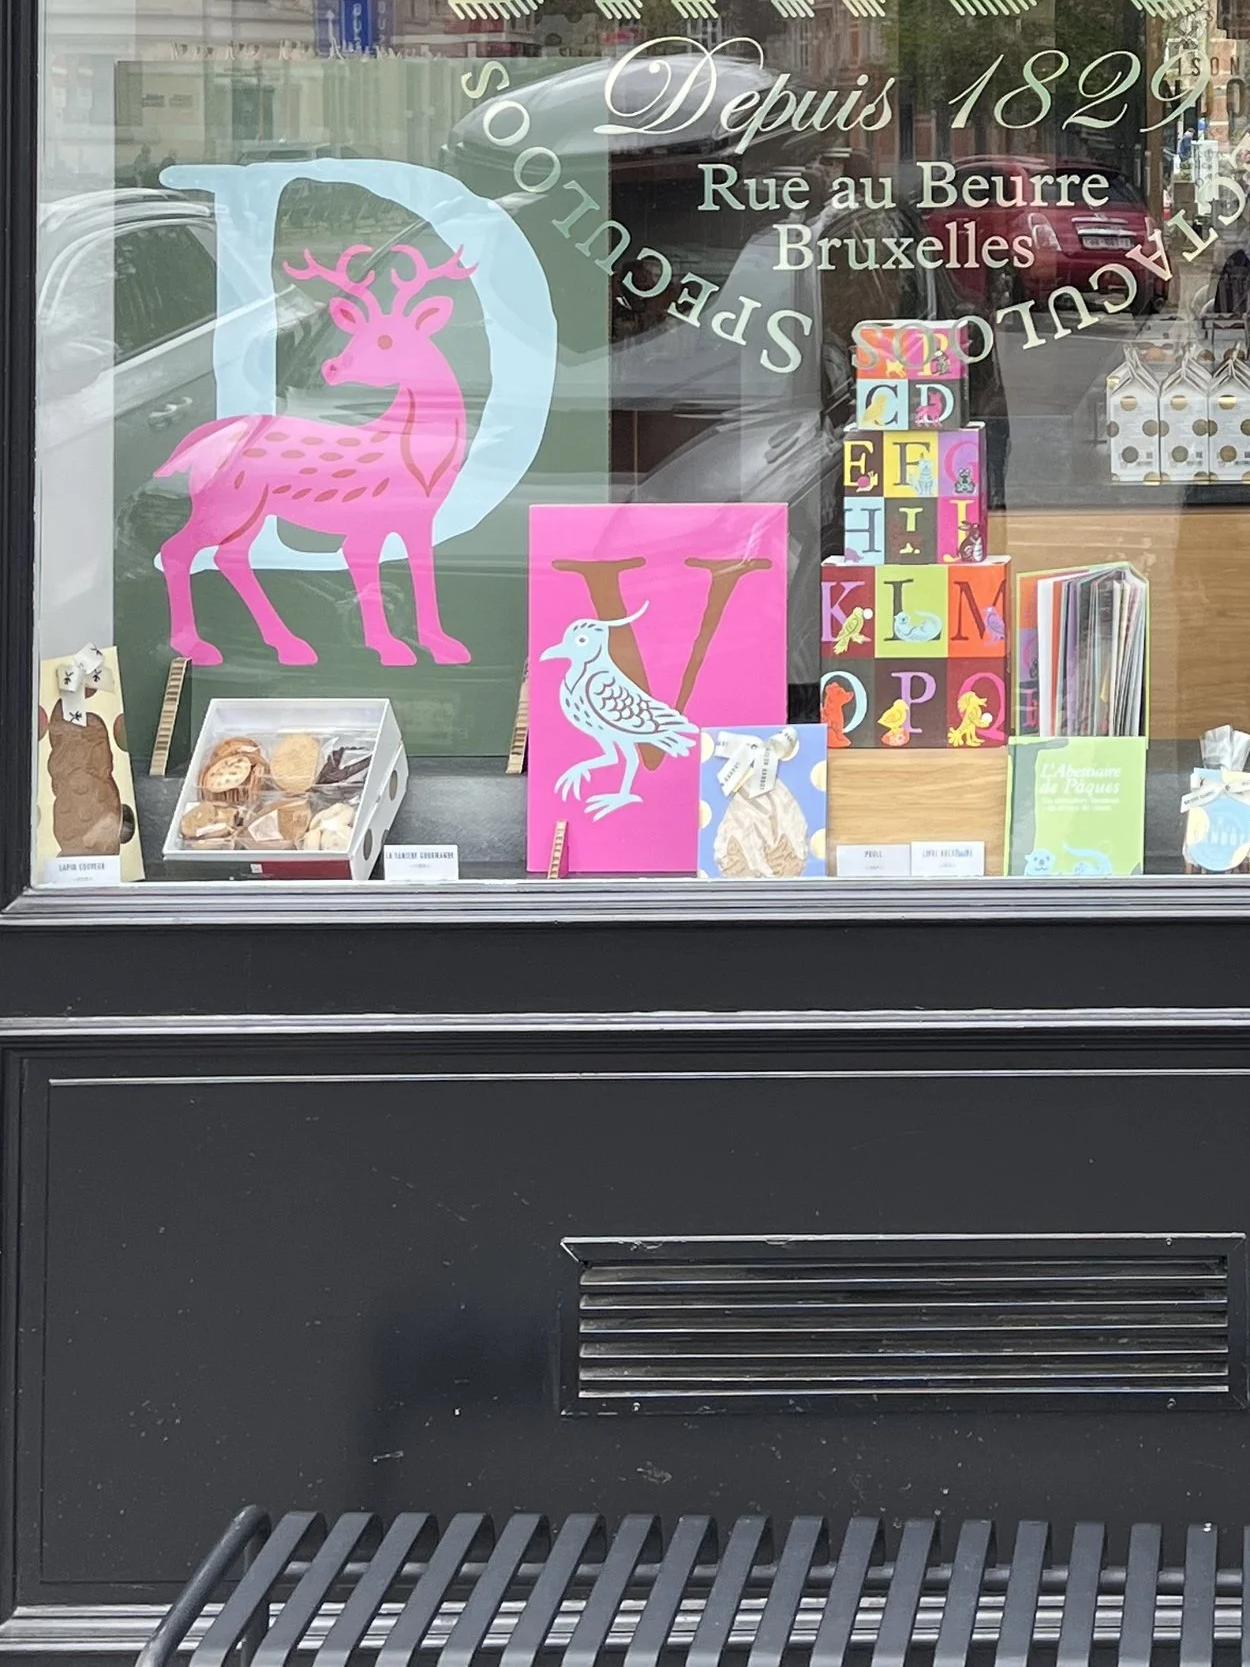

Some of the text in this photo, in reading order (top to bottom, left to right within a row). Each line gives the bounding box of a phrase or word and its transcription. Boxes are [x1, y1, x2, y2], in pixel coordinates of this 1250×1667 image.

[594, 37, 897, 154] Depuis
[949, 49, 1209, 133] 1829
[461, 60, 813, 374] SPECULOOS
[698, 161, 1110, 211] Rue au Beurre
[773, 221, 1035, 272] Bruxelles
